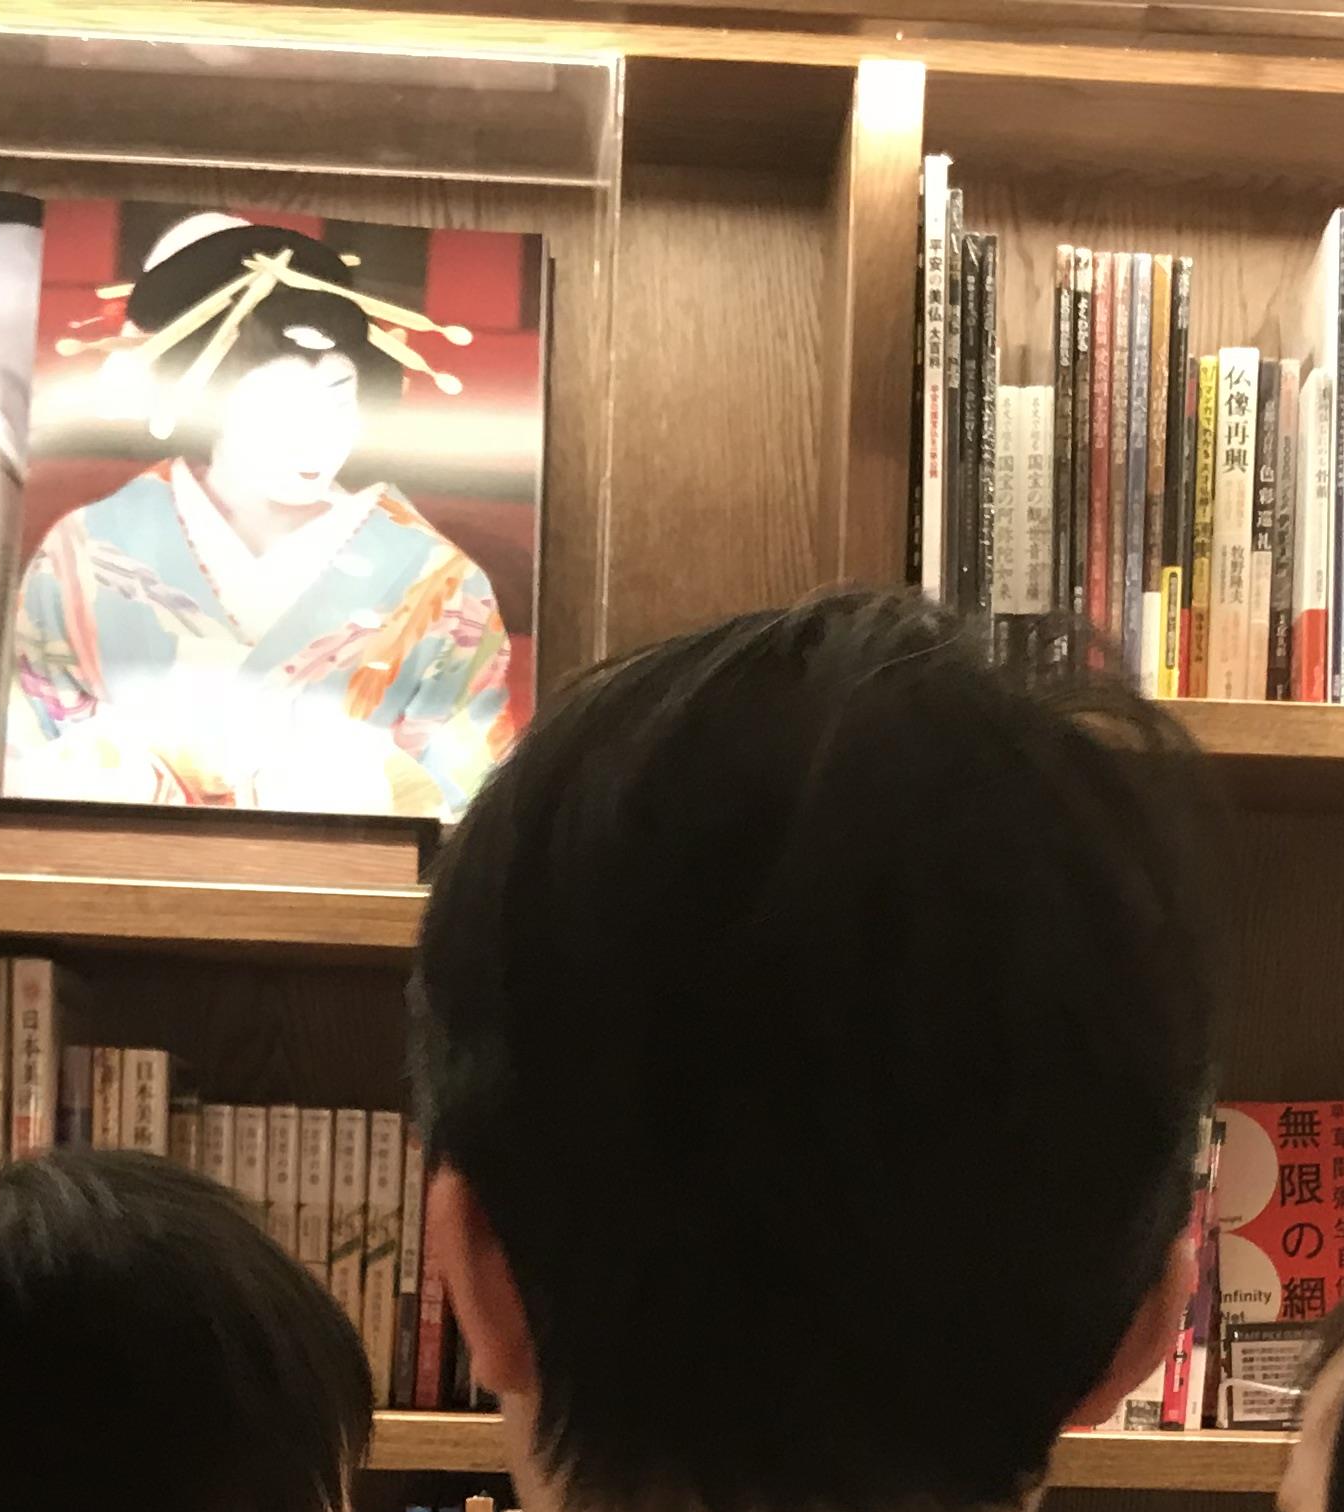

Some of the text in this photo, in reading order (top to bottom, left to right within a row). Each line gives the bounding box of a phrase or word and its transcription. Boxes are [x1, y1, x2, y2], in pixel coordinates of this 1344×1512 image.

[1222, 366, 1253, 474] 仏像再興
[1278, 1106, 1326, 1319] 無限の網
